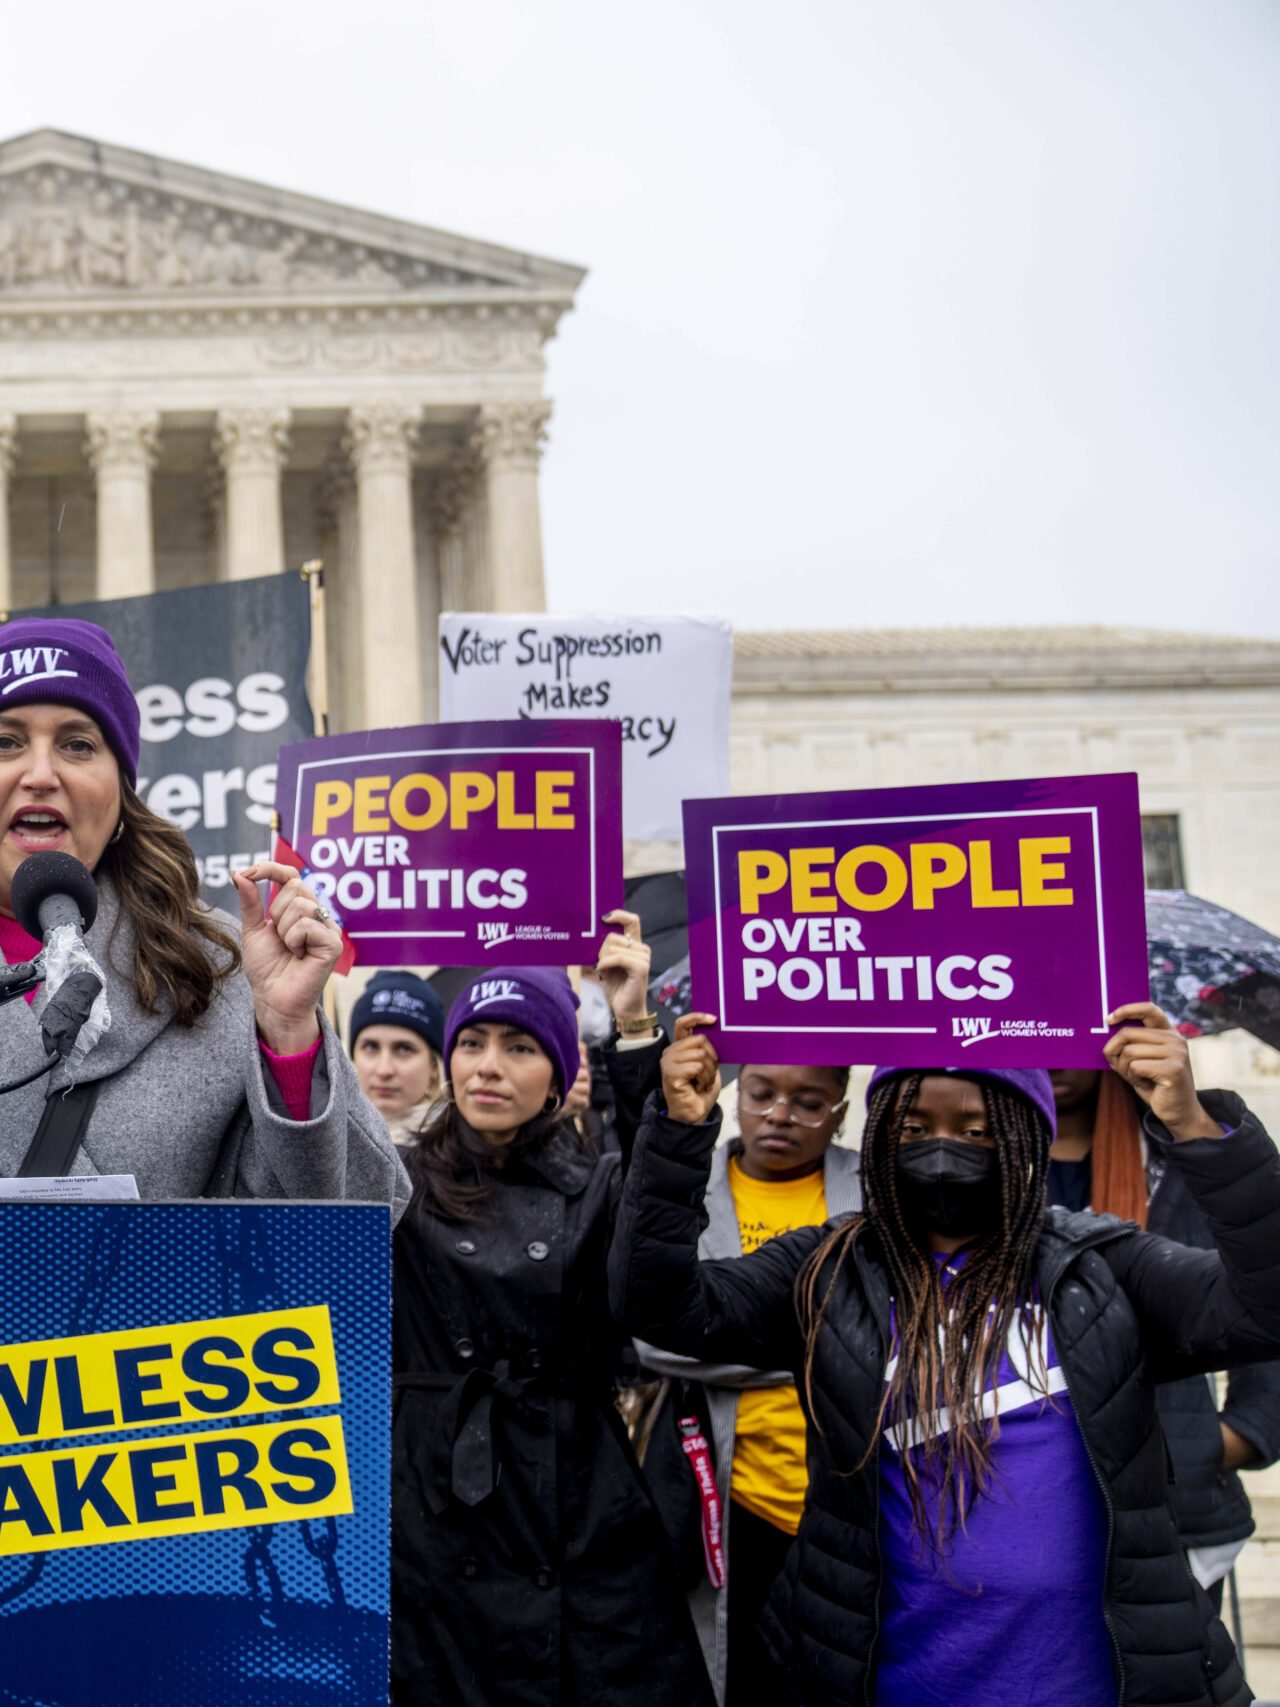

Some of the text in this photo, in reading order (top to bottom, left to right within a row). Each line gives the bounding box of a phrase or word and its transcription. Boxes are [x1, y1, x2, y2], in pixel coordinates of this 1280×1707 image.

[440, 628, 662, 681] Voter Suppression
[523, 680, 611, 711] Makes
[312, 771, 575, 836] PEOPLE
[310, 834, 411, 868] OVER
[738, 836, 1074, 915] PEOPLE
[477, 922, 510, 940] LWV
[543, 932, 570, 940] VOTERS
[741, 917, 866, 952] OVER
[742, 954, 1014, 1001] POLITICS
[951, 1017, 992, 1038] LWV
[1000, 1020, 1035, 1029] LEAGUE
[1000, 1028, 1074, 1037] WOMEN VOTERS
[696, 1455, 715, 1497] Theta
